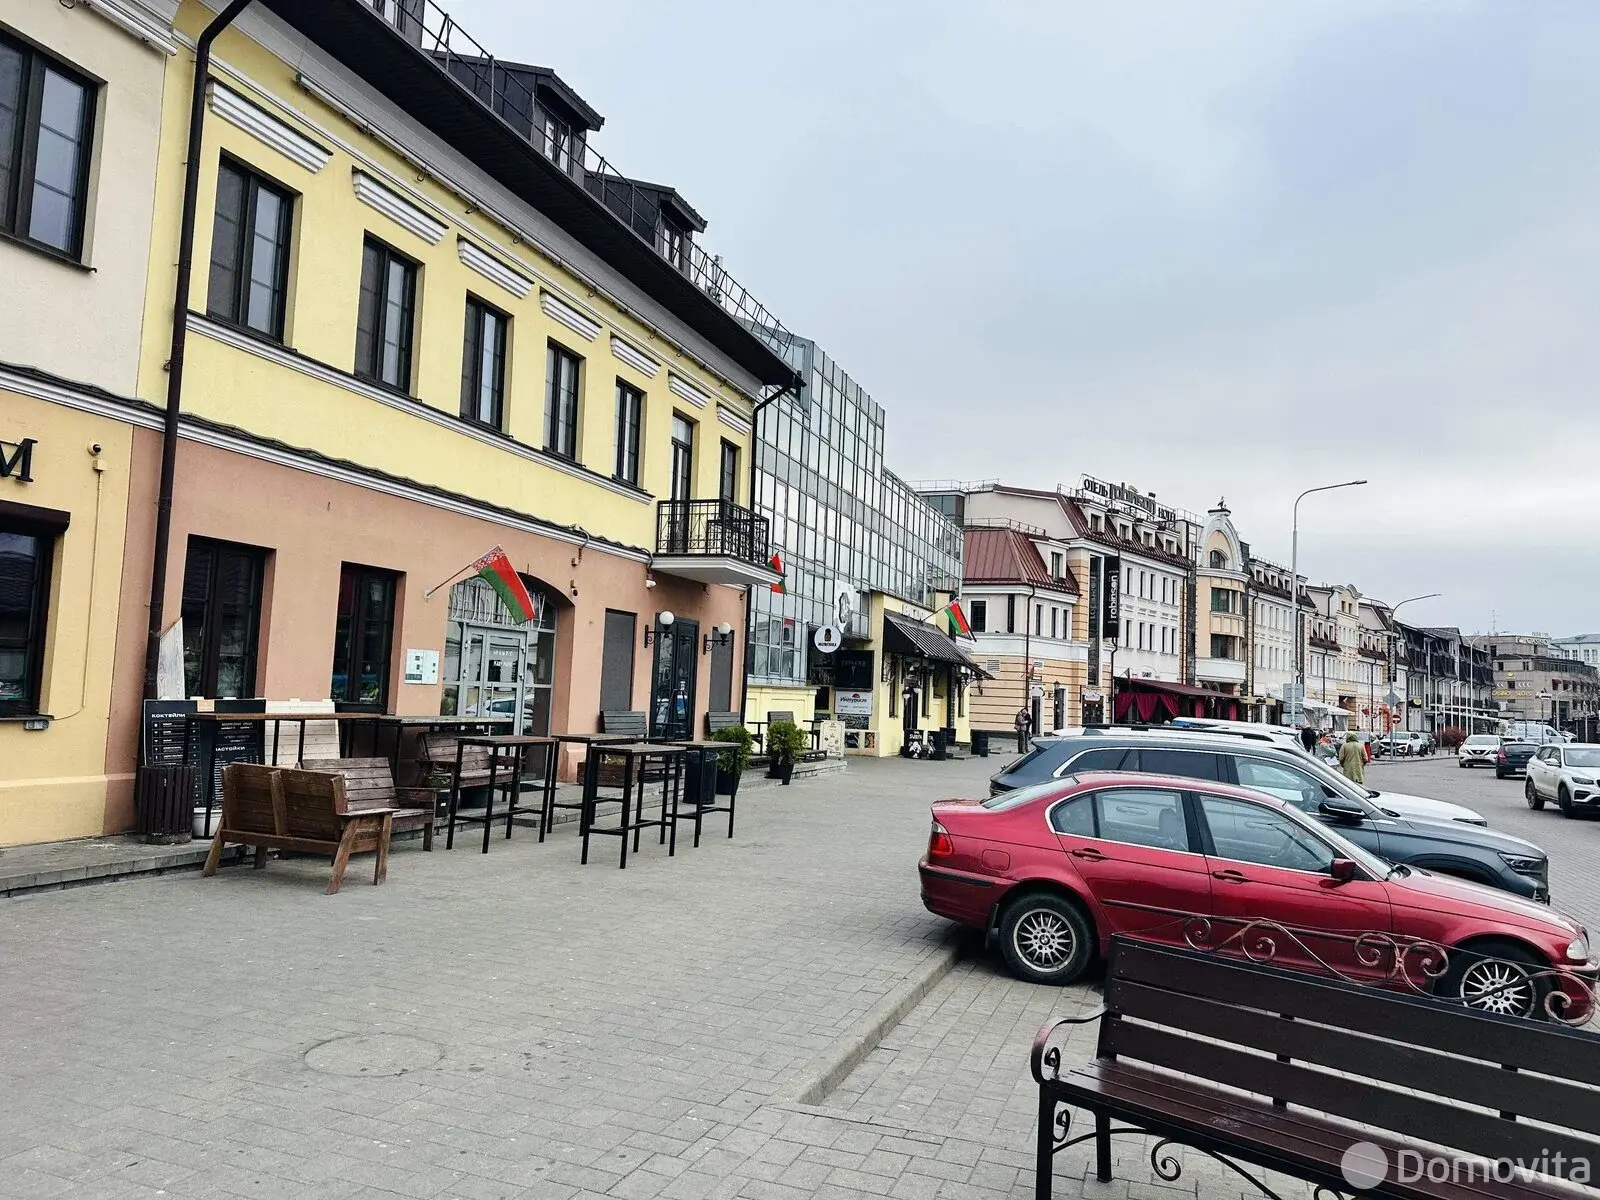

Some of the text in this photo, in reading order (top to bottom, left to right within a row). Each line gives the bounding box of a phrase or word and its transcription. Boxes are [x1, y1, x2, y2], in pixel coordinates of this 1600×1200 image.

[1084, 479, 1108, 497] ОТЕЛЬ
[1109, 482, 1156, 515] robinson
[1109, 575, 1118, 619] robinson
